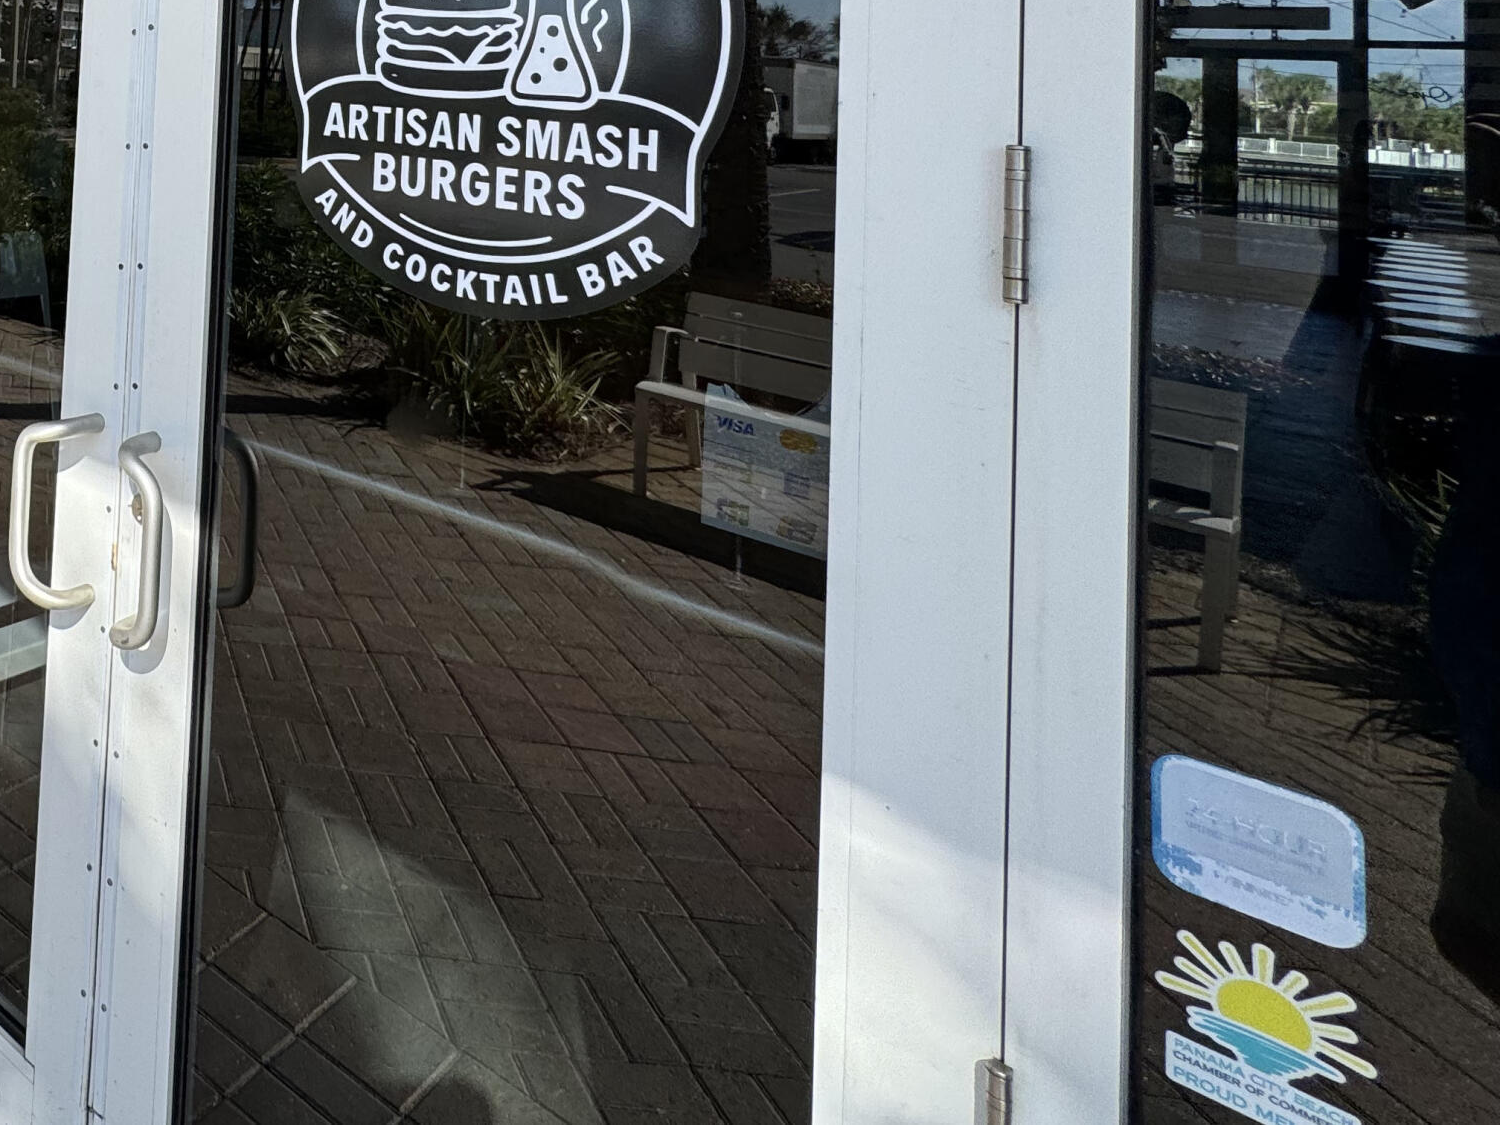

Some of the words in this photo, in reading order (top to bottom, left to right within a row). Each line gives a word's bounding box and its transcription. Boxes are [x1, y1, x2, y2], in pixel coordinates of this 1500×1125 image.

[323, 102, 481, 153] ARTISAN
[497, 116, 659, 172] SMASH
[372, 153, 586, 220] BURGERS
[315, 188, 375, 249] AND
[382, 243, 568, 306] COCKTAIL
[576, 235, 665, 299] BAR
[714, 414, 756, 436] VISA
[1173, 1051, 1241, 1087] CHAMBER
[1245, 1083, 1266, 1097] OF
[1173, 1066, 1248, 1108] PROUD
[1174, 1038, 1245, 1078] PANAMA
[1251, 1073, 1288, 1096] CITY
[1294, 1093, 1354, 1125] BEACH
